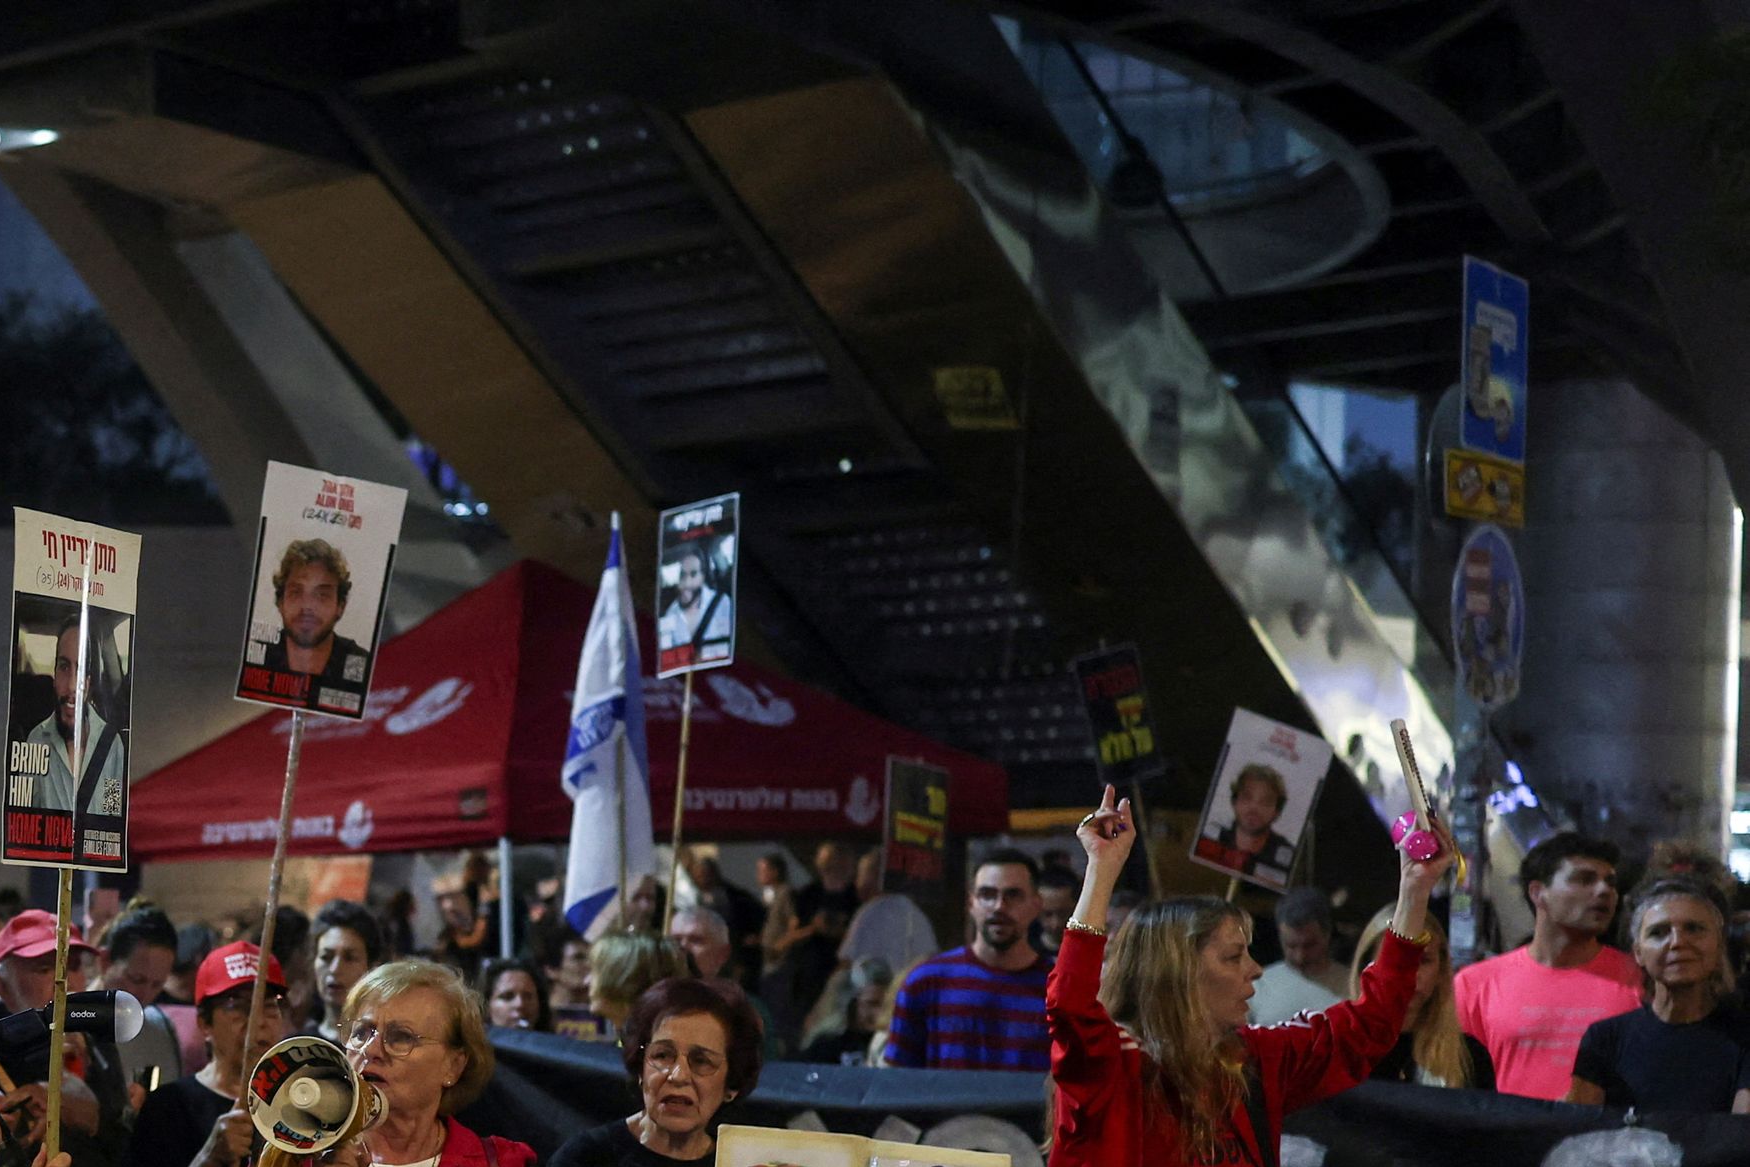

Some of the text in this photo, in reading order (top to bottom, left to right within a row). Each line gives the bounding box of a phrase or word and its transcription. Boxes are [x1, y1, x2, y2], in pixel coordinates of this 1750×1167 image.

[42, 530, 58, 560] חי
[93, 541, 116, 575] מתן
[10, 741, 50, 776] BRING
[9, 774, 34, 808] HIM
[7, 811, 43, 846] HOME
